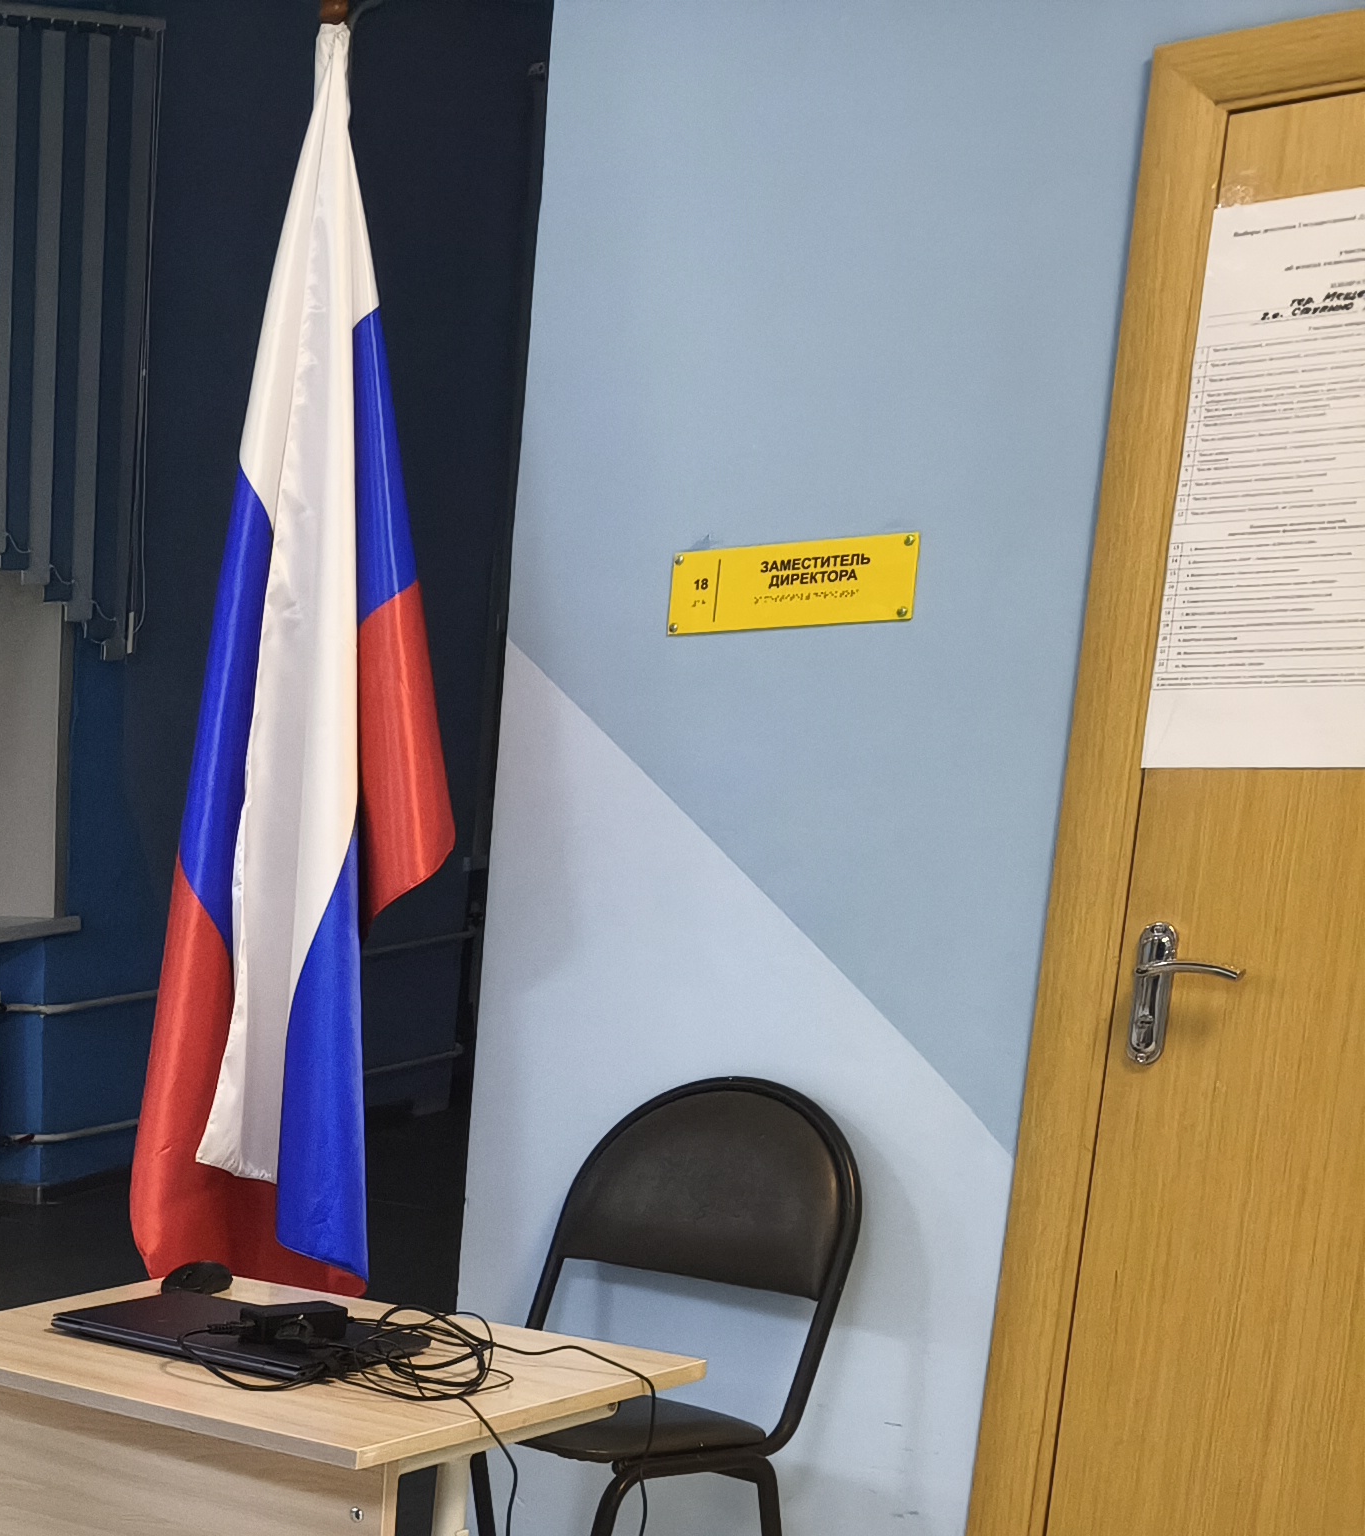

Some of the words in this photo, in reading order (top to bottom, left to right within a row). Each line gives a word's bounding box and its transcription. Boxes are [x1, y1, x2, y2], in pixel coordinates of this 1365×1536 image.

[759, 553, 871, 573] ЗАМЕСТИТЕЛЬ
[693, 578, 709, 591] 18
[768, 569, 858, 589] ДИРЕКТОРА
